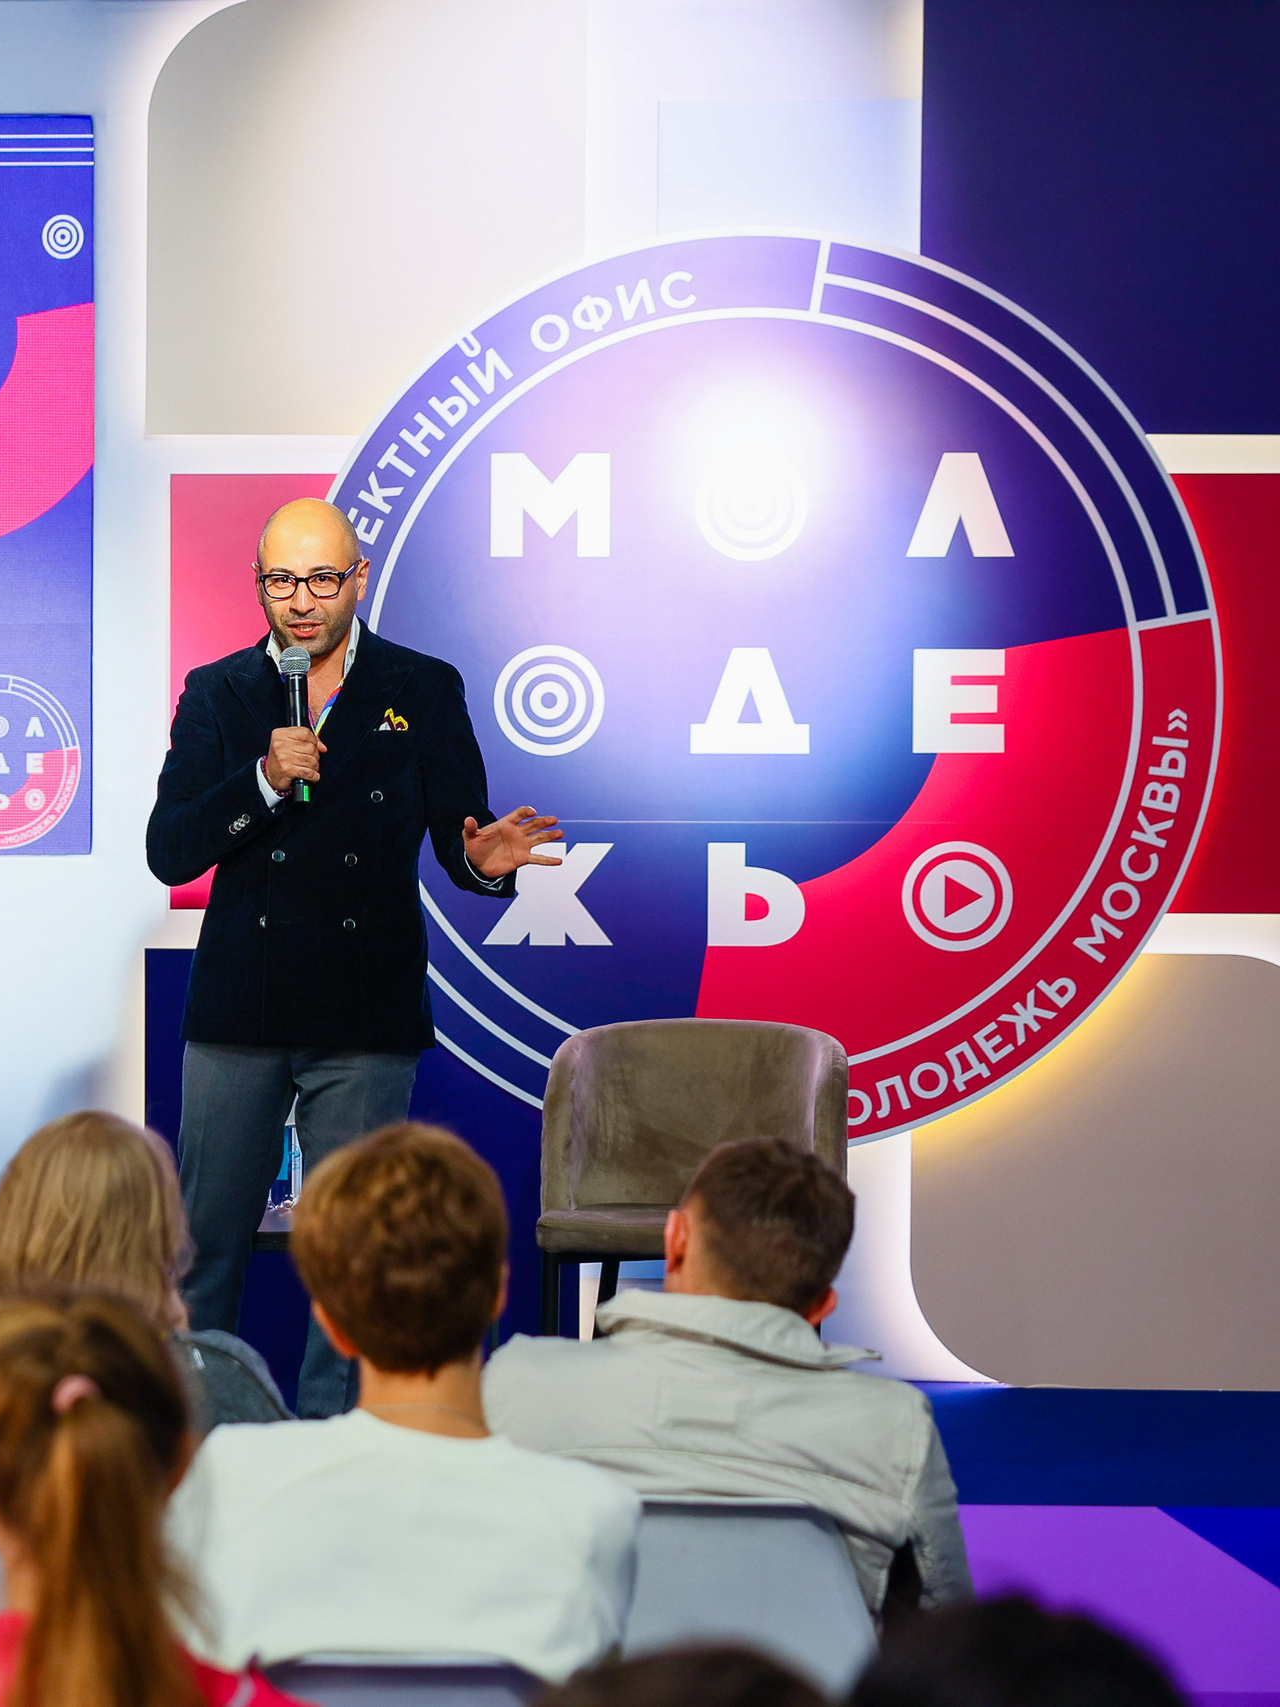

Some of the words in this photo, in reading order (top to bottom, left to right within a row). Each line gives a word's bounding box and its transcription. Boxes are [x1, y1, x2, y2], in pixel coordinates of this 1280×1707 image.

[346, 333, 514, 546] ЕКТНЫЙ
[530, 271, 697, 352] ОФИС
[847, 977, 1077, 1126] ОЛОДЕЖЬ
[1073, 708, 1189, 963] МОСКВЫ»
